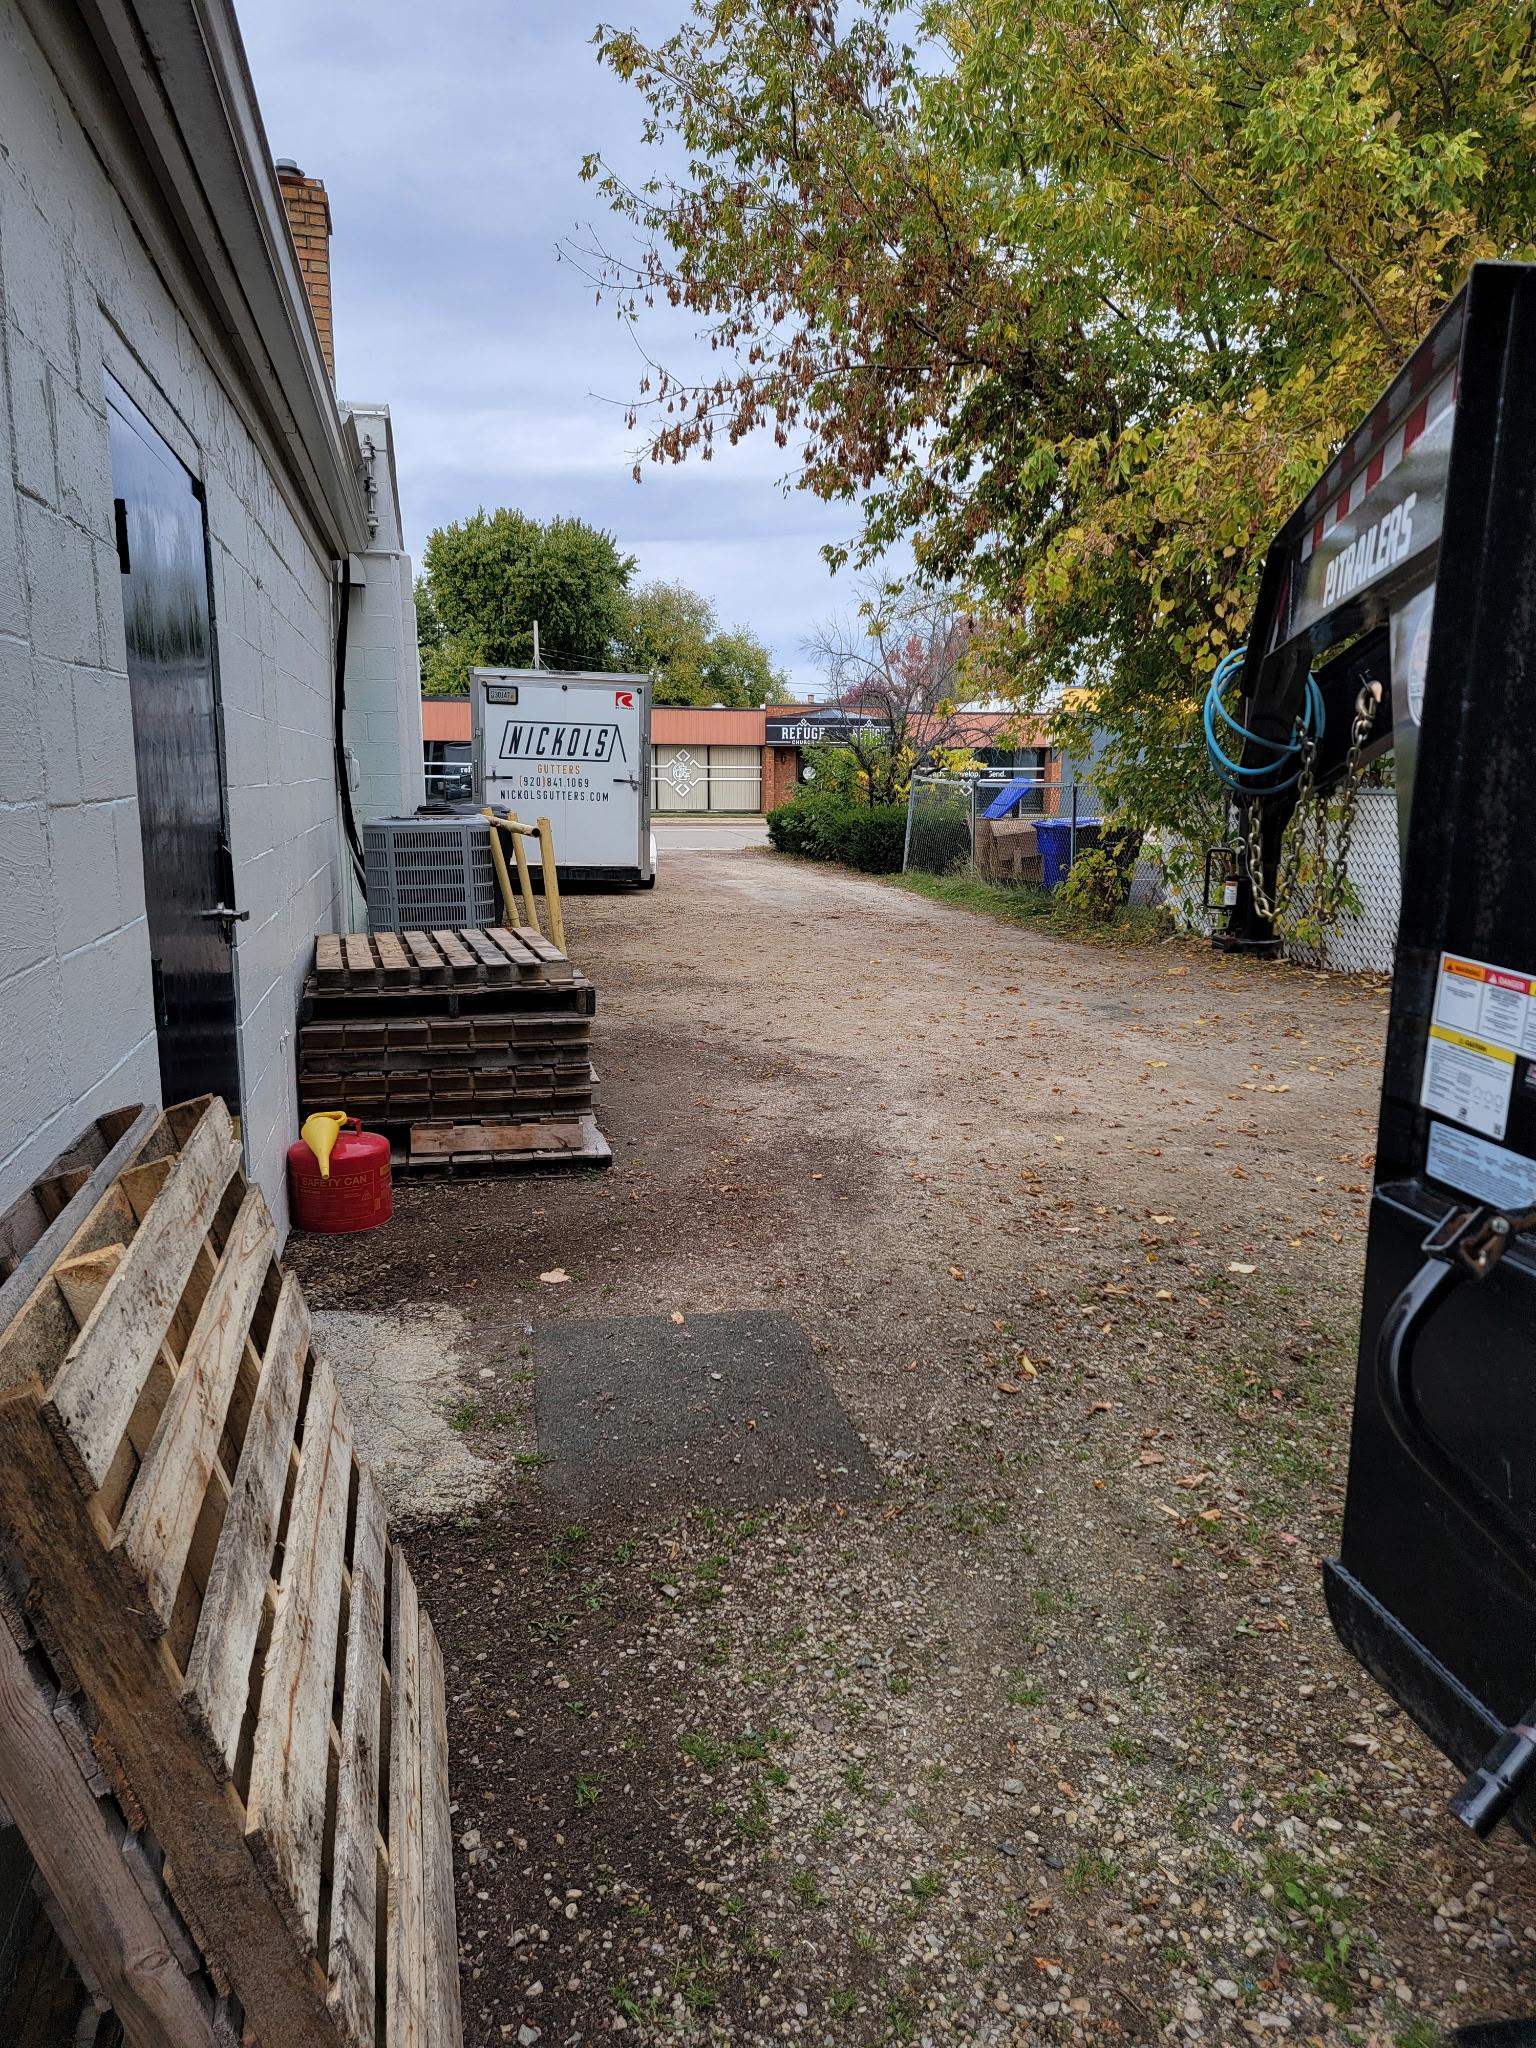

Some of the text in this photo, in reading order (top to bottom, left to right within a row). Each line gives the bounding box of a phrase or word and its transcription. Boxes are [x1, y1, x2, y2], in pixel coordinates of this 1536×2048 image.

[508, 725, 609, 758] NICKOLS
[537, 763, 581, 775] GUTTERS
[500, 789, 610, 802] NICKOLSGUTTERS.COM
[302, 1174, 367, 1187] SAFETY CAN
